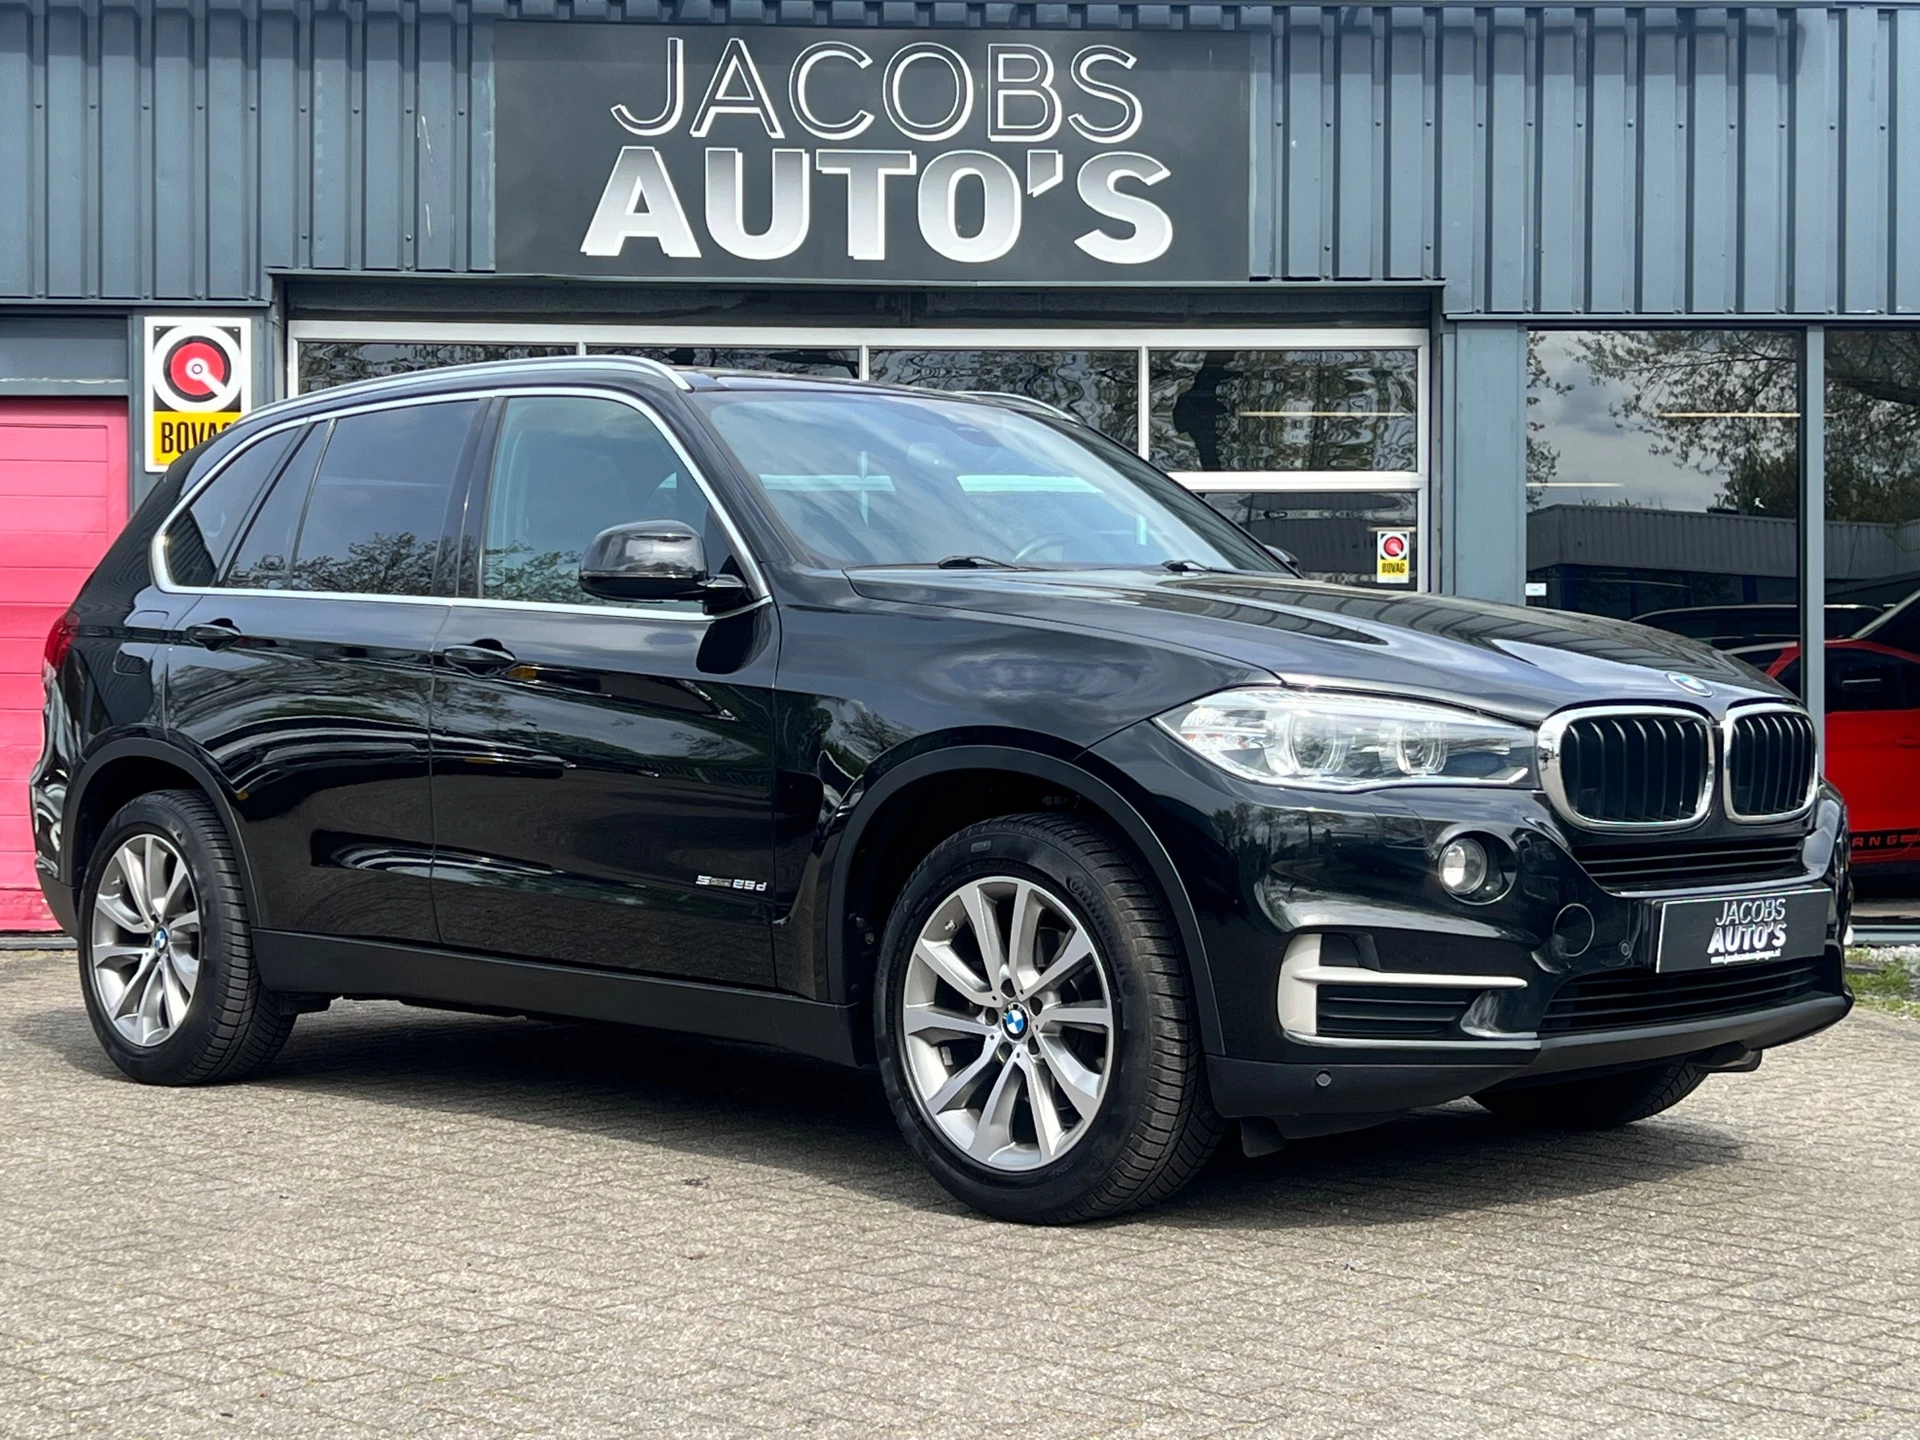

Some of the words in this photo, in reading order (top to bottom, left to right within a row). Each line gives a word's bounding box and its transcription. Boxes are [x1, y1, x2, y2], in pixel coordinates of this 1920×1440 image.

[610, 38, 1143, 145] JACOBS
[579, 146, 1173, 264] AUTO'S
[1381, 562, 1405, 574] BOVAG
[1715, 897, 1787, 926] JACOBS
[1707, 920, 1787, 954] AUTO'S
